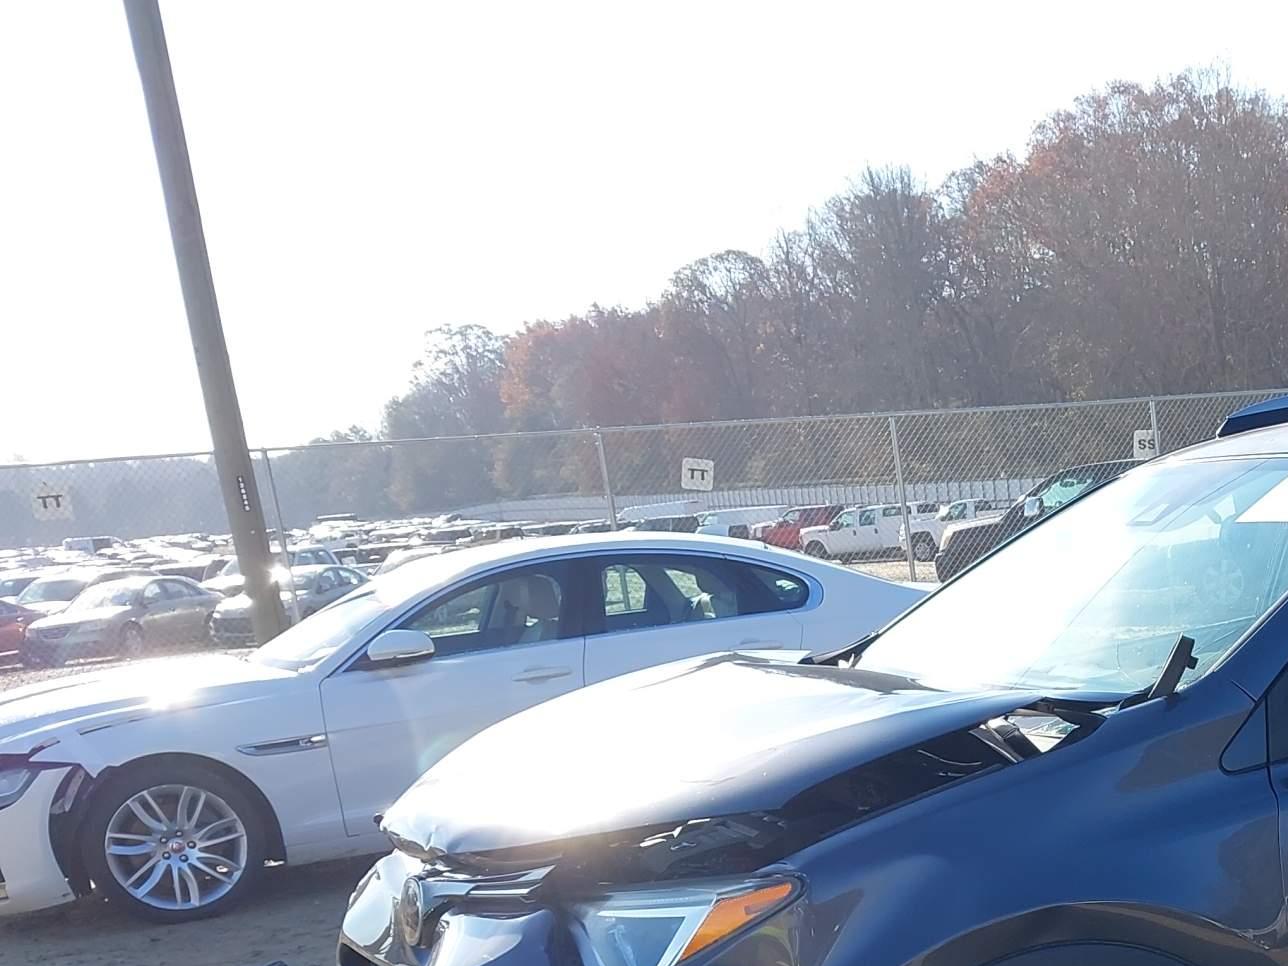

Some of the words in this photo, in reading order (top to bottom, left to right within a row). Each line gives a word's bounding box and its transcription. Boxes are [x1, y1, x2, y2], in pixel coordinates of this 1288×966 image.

[1138, 439, 1156, 450] SS
[687, 468, 709, 481] TT
[37, 494, 63, 509] TT
